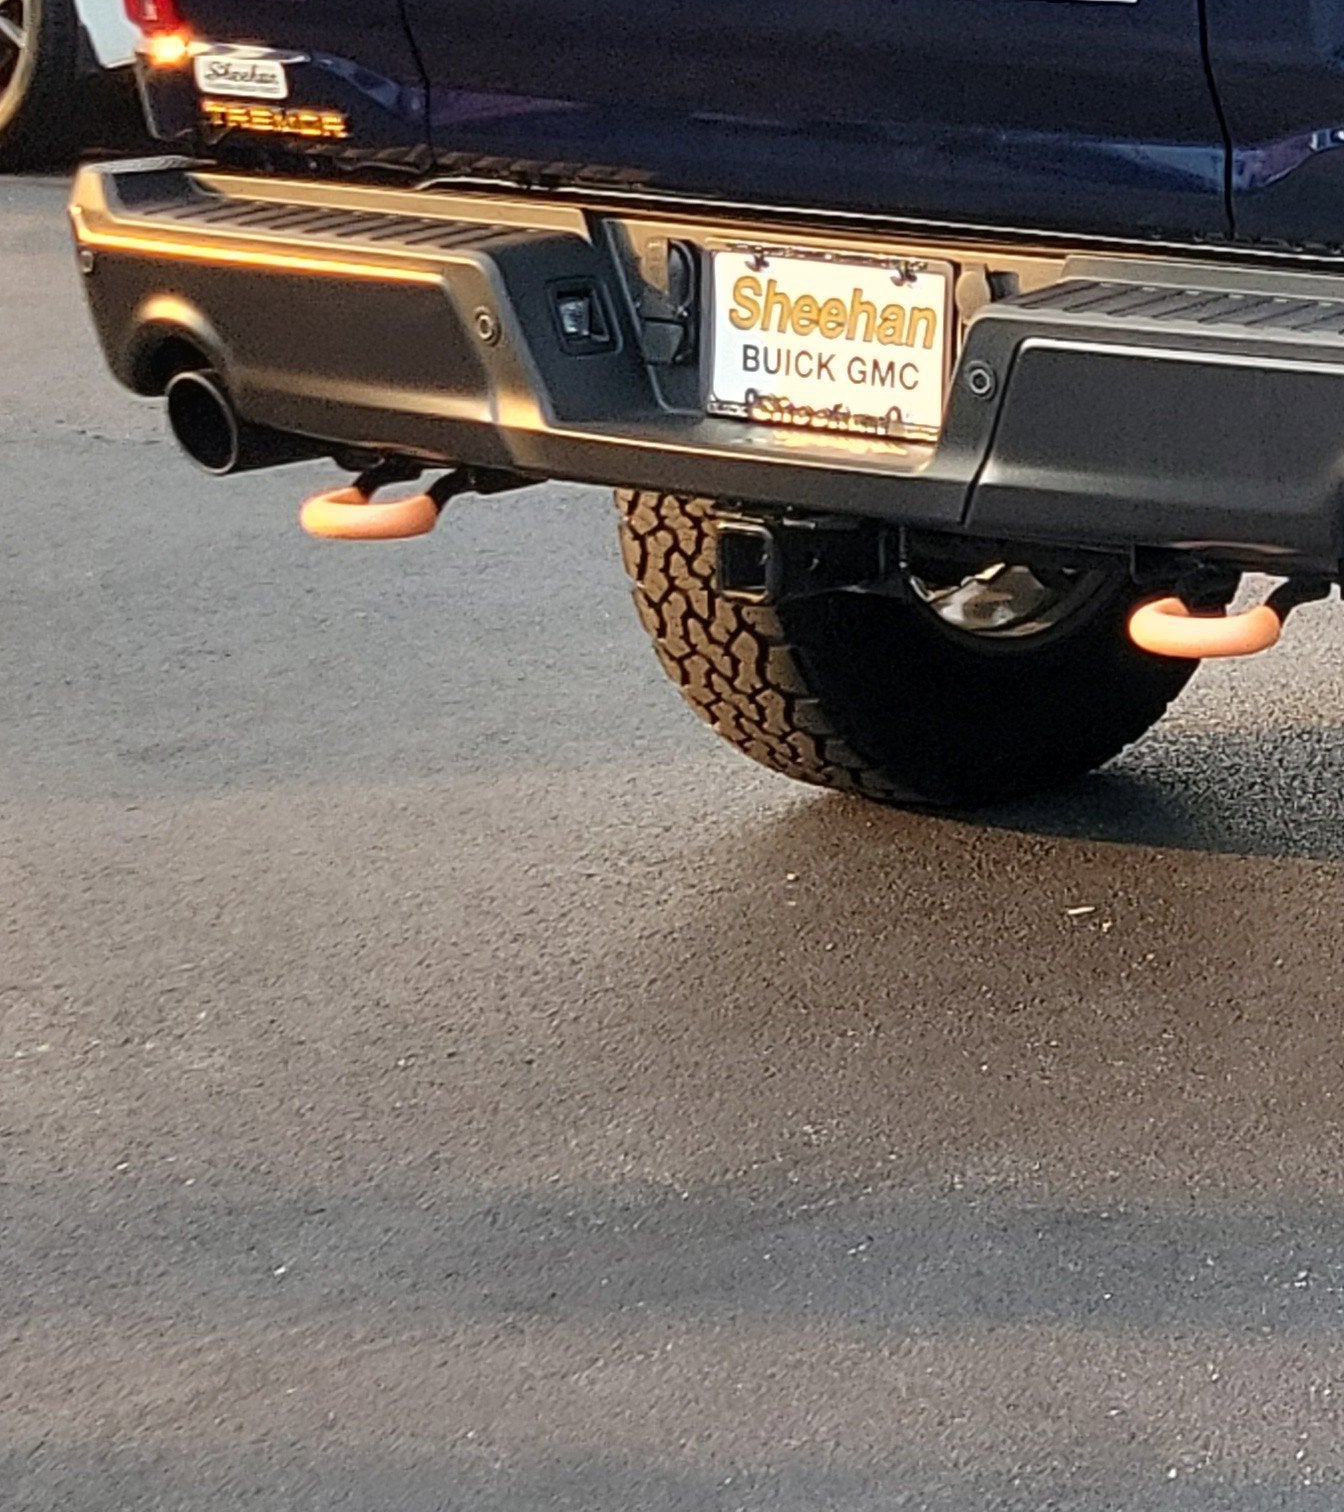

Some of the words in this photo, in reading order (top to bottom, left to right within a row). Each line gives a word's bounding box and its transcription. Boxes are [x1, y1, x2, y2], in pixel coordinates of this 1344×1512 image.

[202, 99, 350, 139] TREMOR
[728, 275, 938, 350] Sheehan
[742, 343, 837, 382] BUICK
[846, 355, 920, 391] GMC
